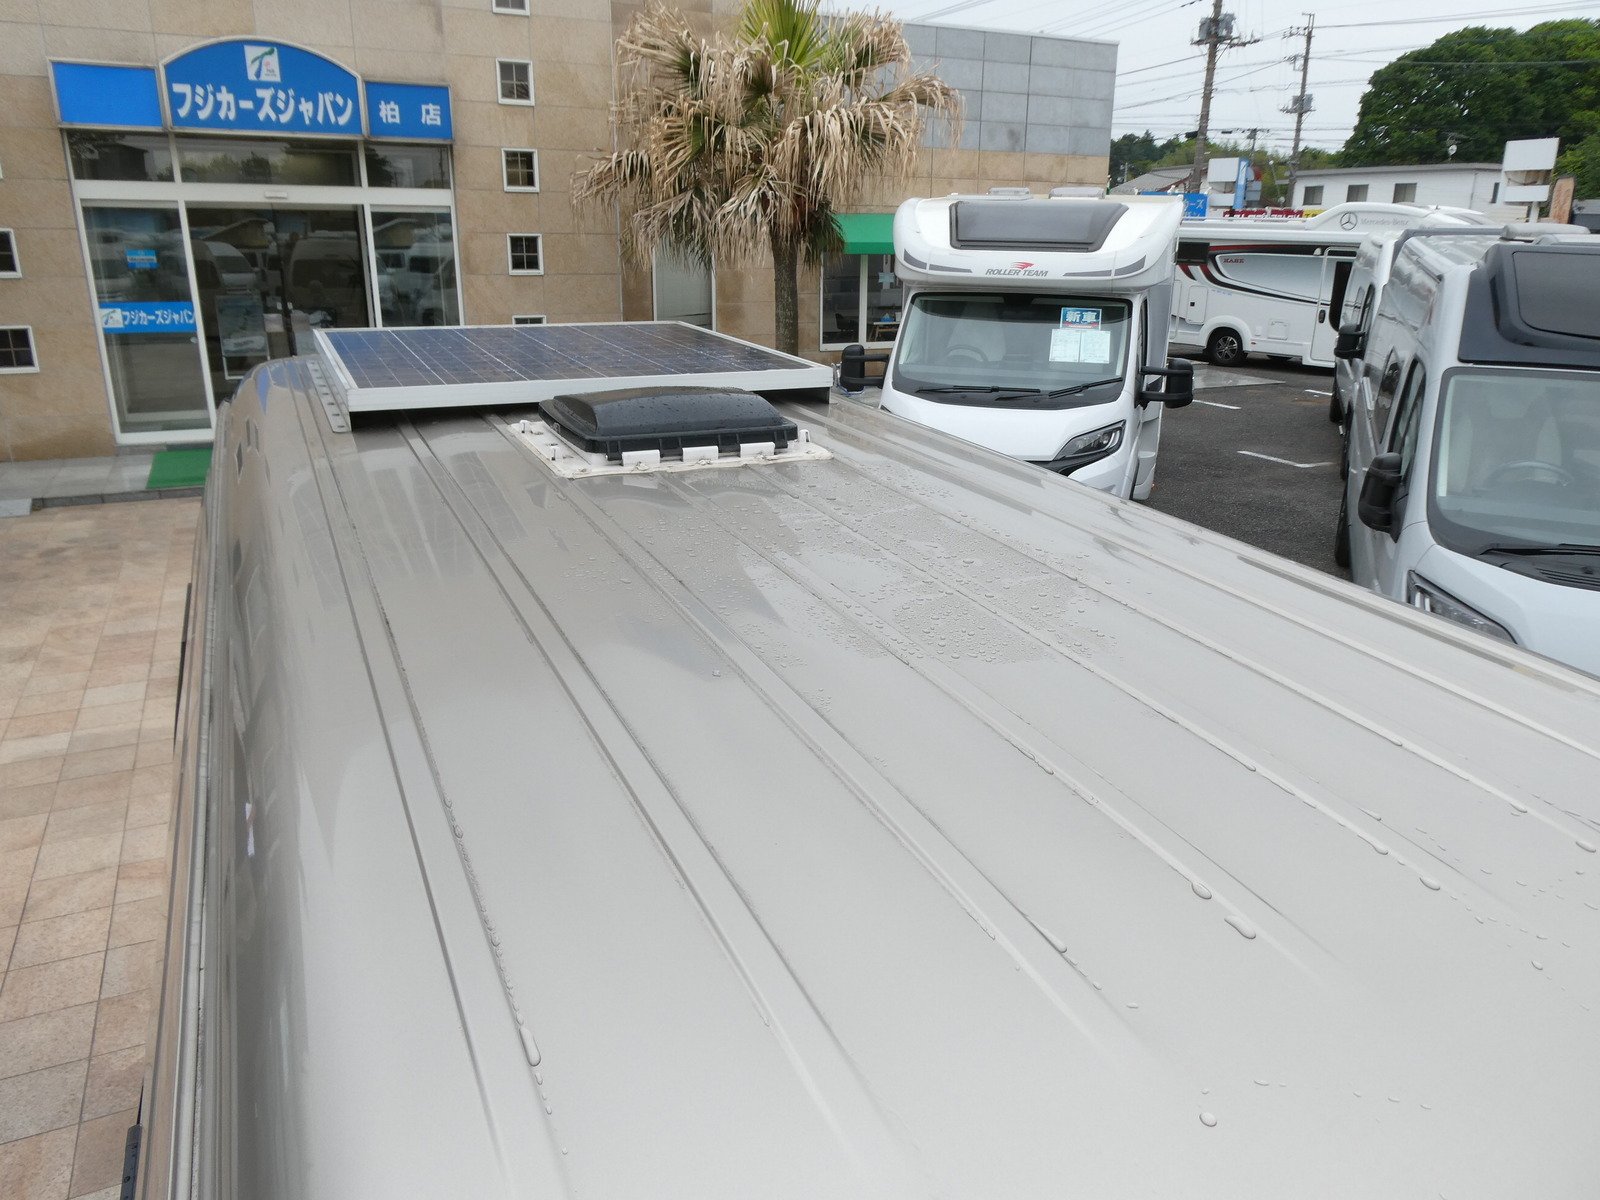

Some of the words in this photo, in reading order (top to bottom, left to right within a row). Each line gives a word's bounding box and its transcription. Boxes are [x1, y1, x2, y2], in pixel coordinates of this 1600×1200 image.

[171, 82, 353, 126] フジカーズジャパン
[1022, 269, 1048, 277] TEAM
[122, 309, 195, 325] フジカーズジャパン
[1066, 311, 1097, 322] 新車
